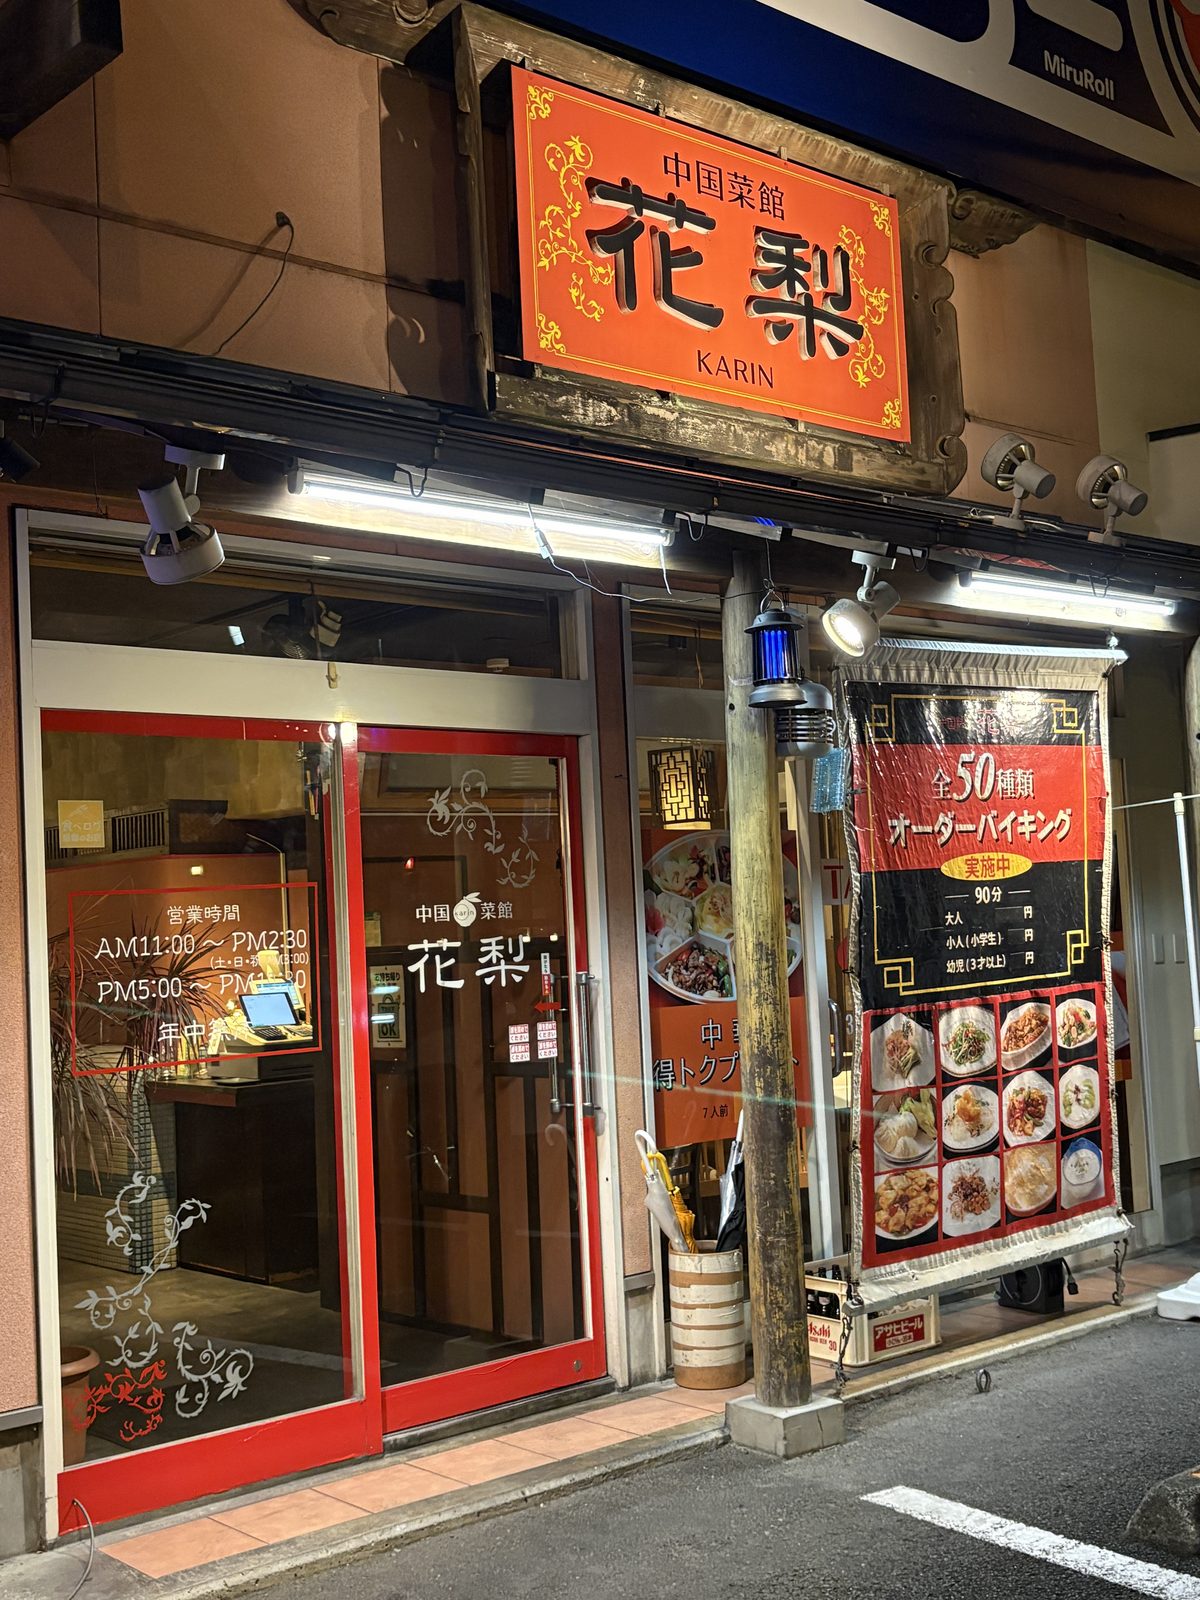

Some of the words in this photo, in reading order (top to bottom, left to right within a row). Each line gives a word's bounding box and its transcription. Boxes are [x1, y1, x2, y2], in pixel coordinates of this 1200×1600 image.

[1043, 49, 1115, 100] MiruRoll
[662, 151, 786, 220] 中国菜館
[584, 176, 864, 362] 花梨
[696, 349, 775, 389] KARIN
[932, 752, 1035, 802] 全50種類
[888, 808, 1073, 848] オーダーバイキング
[965, 856, 1011, 878] 実施中
[975, 886, 1002, 905] 90分
[167, 904, 241, 924] 営業時間
[415, 904, 450, 923] 中国
[480, 901, 513, 920] 菜館
[945, 911, 964, 926] 大人
[1023, 905, 1033, 919] 円
[94, 934, 195, 960] AM11:00
[231, 929, 307, 952] PM2:30
[1024, 928, 1034, 942] 円
[407, 934, 530, 993] 花梨
[1025, 951, 1035, 965] 円
[97, 977, 182, 1003] PM5:00
[381, 1023, 397, 1036] OK
[875, 1317, 923, 1340] アサヒビール
[828, 1340, 837, 1352] 30
